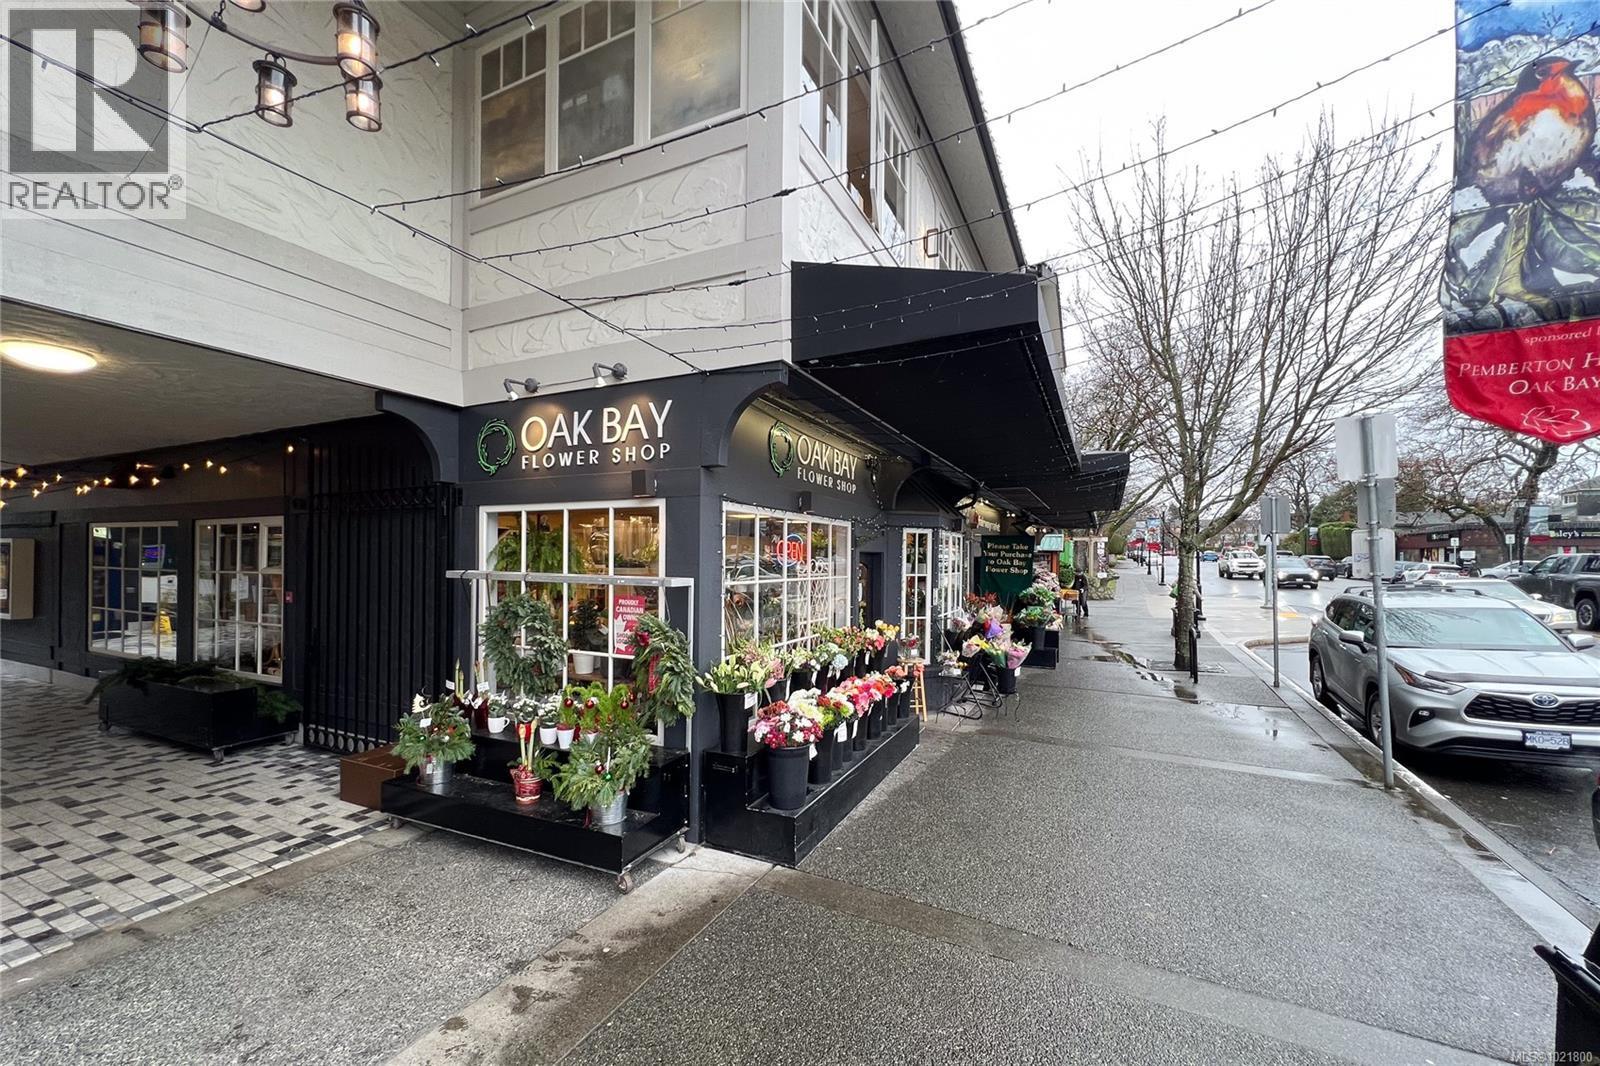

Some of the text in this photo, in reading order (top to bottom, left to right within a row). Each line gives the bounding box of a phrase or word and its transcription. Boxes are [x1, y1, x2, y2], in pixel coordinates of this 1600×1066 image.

[1524, 326, 1592, 346] sponsored
[1458, 357, 1574, 377] PEMBERTON
[1509, 375, 1600, 395] OAK BAY
[521, 399, 673, 452] OAK BAY
[521, 443, 671, 470] FLOWER SHOP
[797, 434, 858, 480] OAK BAY
[797, 466, 857, 494] FLOWER SHOP
[776, 539, 804, 565] OPEN
[987, 542, 1010, 550] Please
[996, 558, 1011, 566] Oak
[1013, 559, 1027, 567] Bay
[1010, 566, 1029, 575] Shop
[615, 606, 644, 614] CANADIAN
